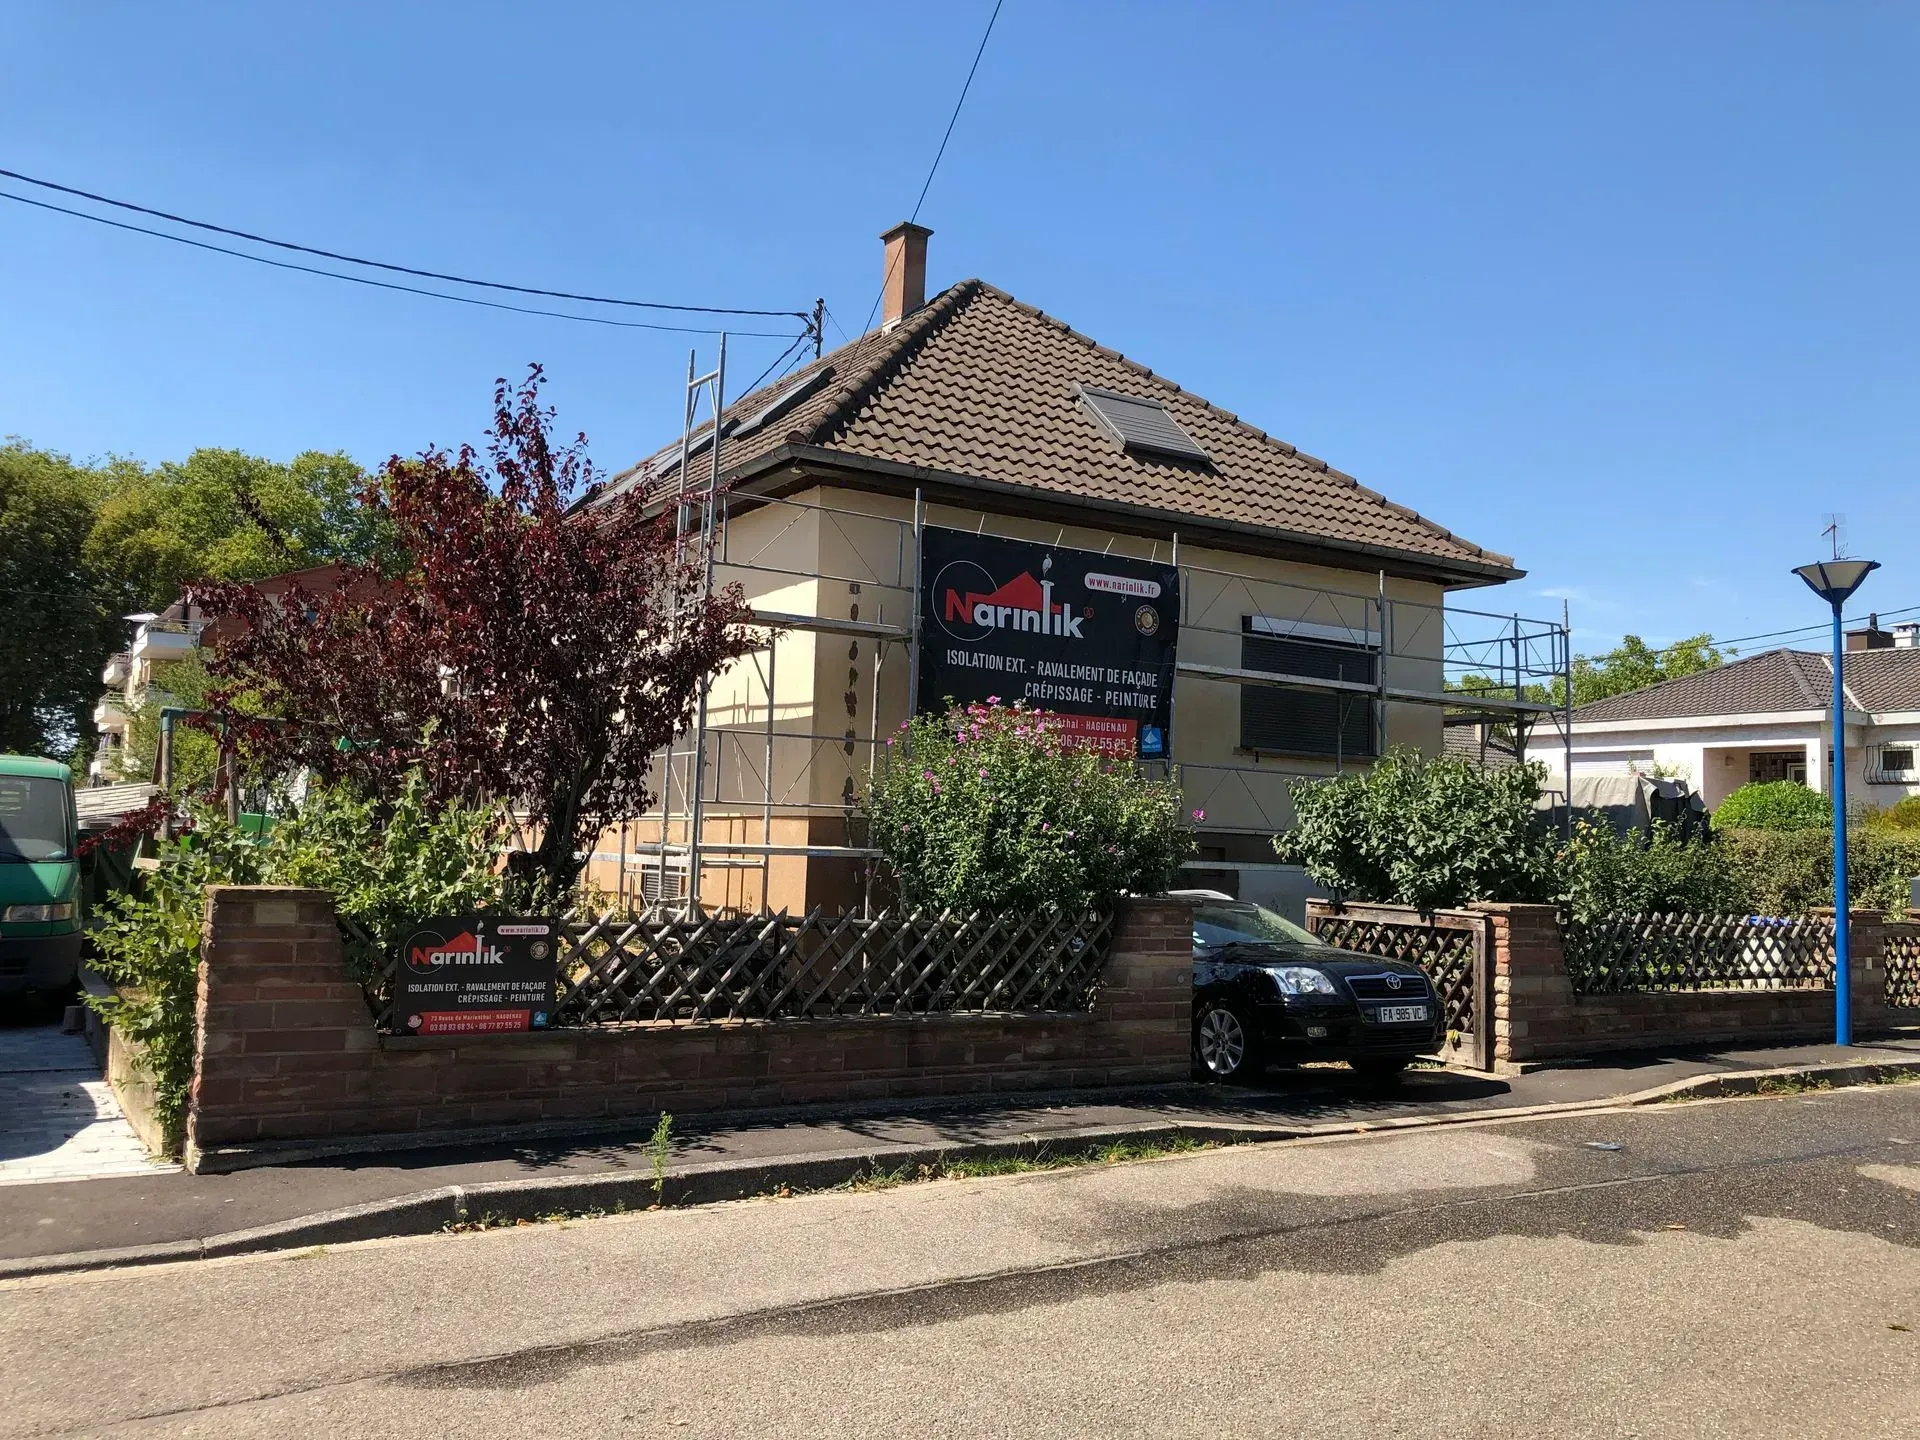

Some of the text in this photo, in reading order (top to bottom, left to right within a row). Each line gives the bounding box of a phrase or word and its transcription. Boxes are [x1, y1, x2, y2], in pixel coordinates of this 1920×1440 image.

[1088, 577, 1155, 596] www.narinlik.fr
[944, 579, 1084, 639] Narinlik
[947, 649, 1003, 672] ISOLATION
[1006, 657, 1027, 674] EXT.
[1037, 660, 1104, 683] RAVALEMENT
[1107, 668, 1120, 684] DE
[1122, 670, 1158, 690] FAÇADE
[1025, 680, 1093, 704] CRÉPISSAGE
[1105, 691, 1157, 709] PEINTURE
[1086, 720, 1128, 733] HAGUENAU
[412, 934, 504, 966] Narinlik
[408, 983, 444, 993] ISOLATION
[445, 983, 460, 992] EXT.
[466, 982, 511, 992] RAVALEMENT
[512, 982, 520, 991] DE
[521, 981, 546, 993] FAÇADE
[458, 993, 503, 1004] CRÉPISSAGE
[510, 994, 545, 1003] PEINTURE
